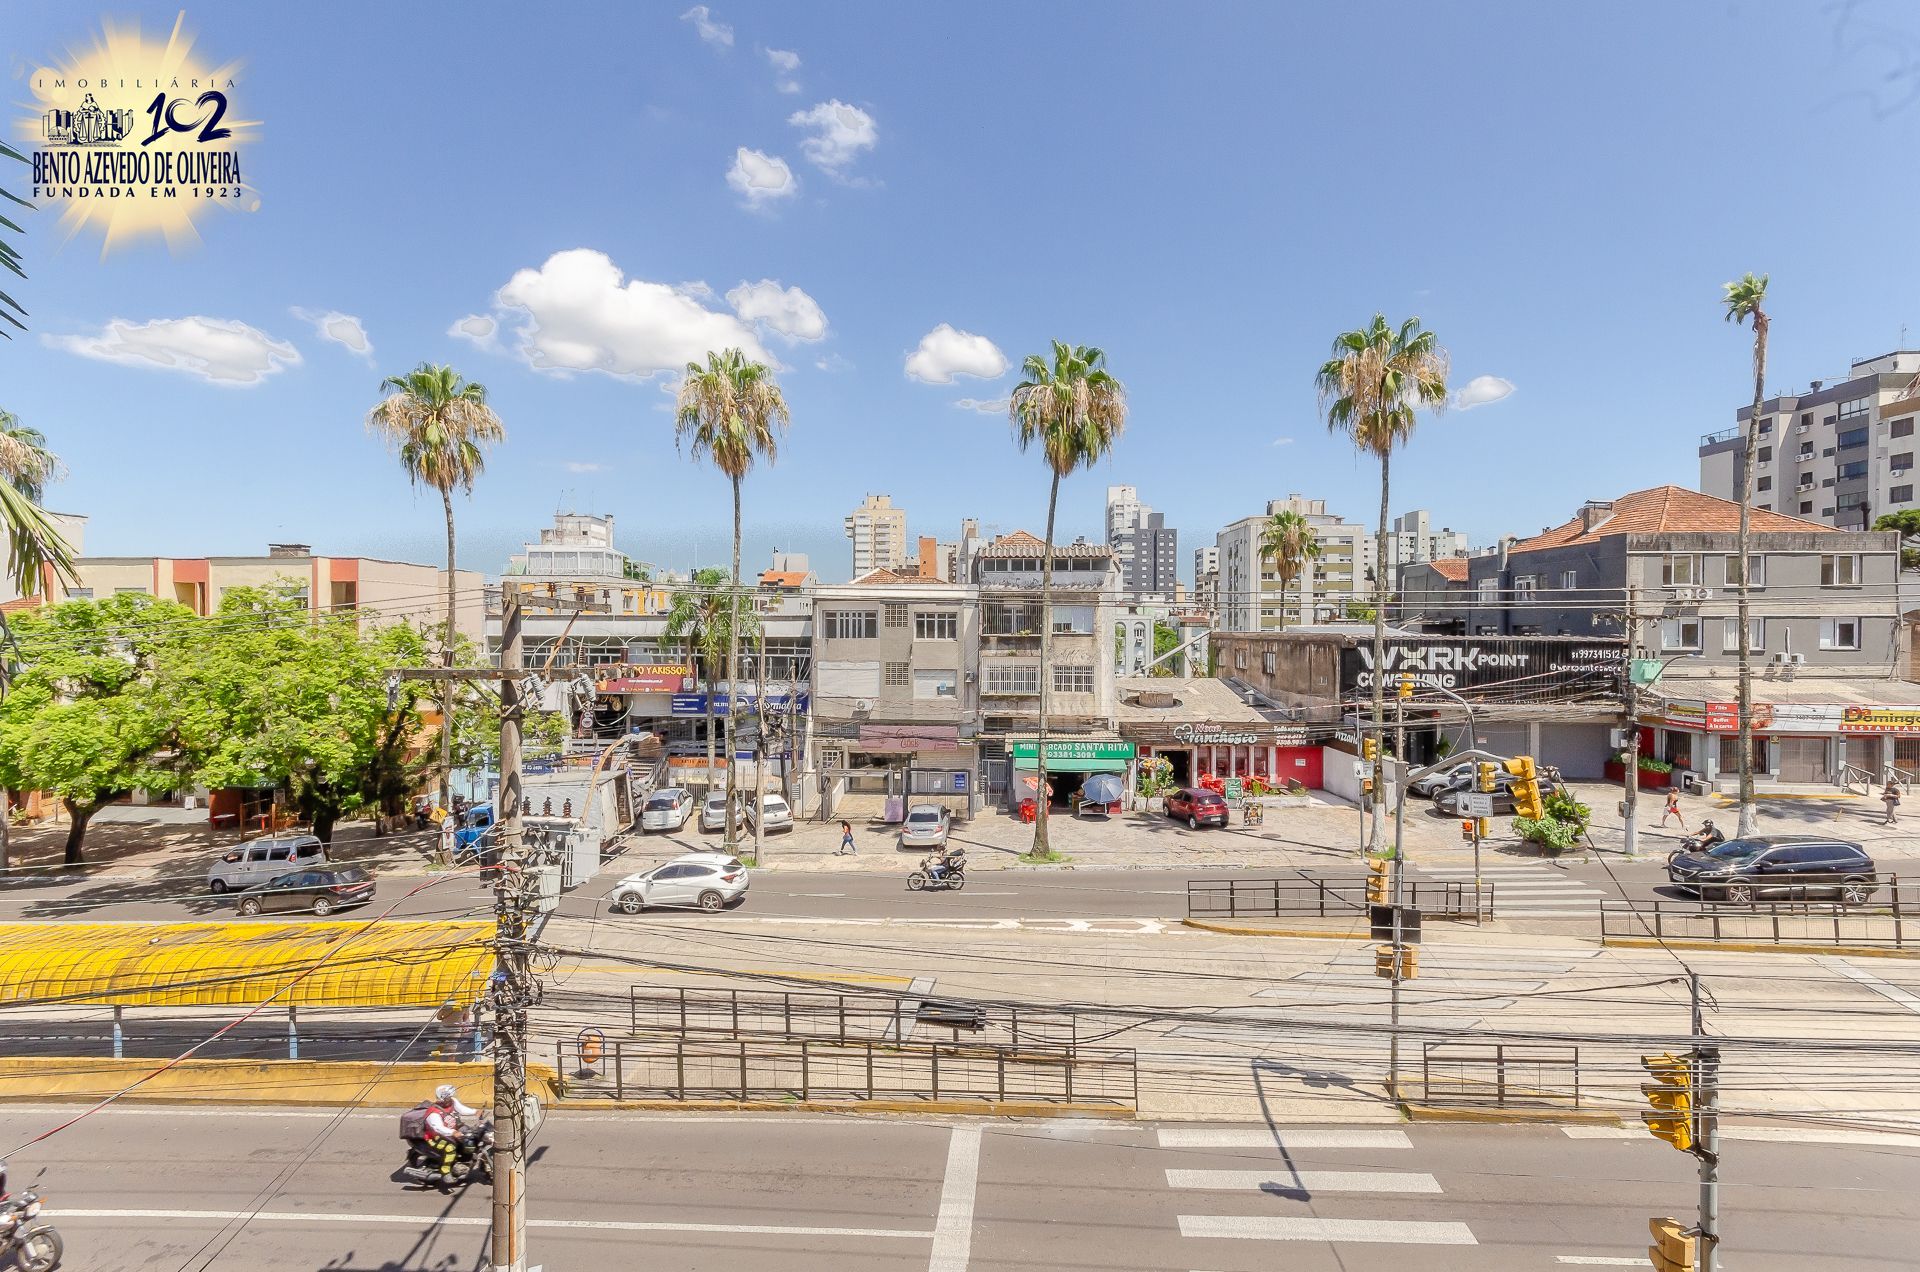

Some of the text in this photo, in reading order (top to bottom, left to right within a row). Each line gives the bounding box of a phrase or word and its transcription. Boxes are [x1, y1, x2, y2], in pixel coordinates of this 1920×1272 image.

[1477, 654, 1529, 667] POINT
[1020, 743, 1036, 751] MINI
[1074, 743, 1105, 751] SANTA
[1107, 743, 1129, 752] RITA
